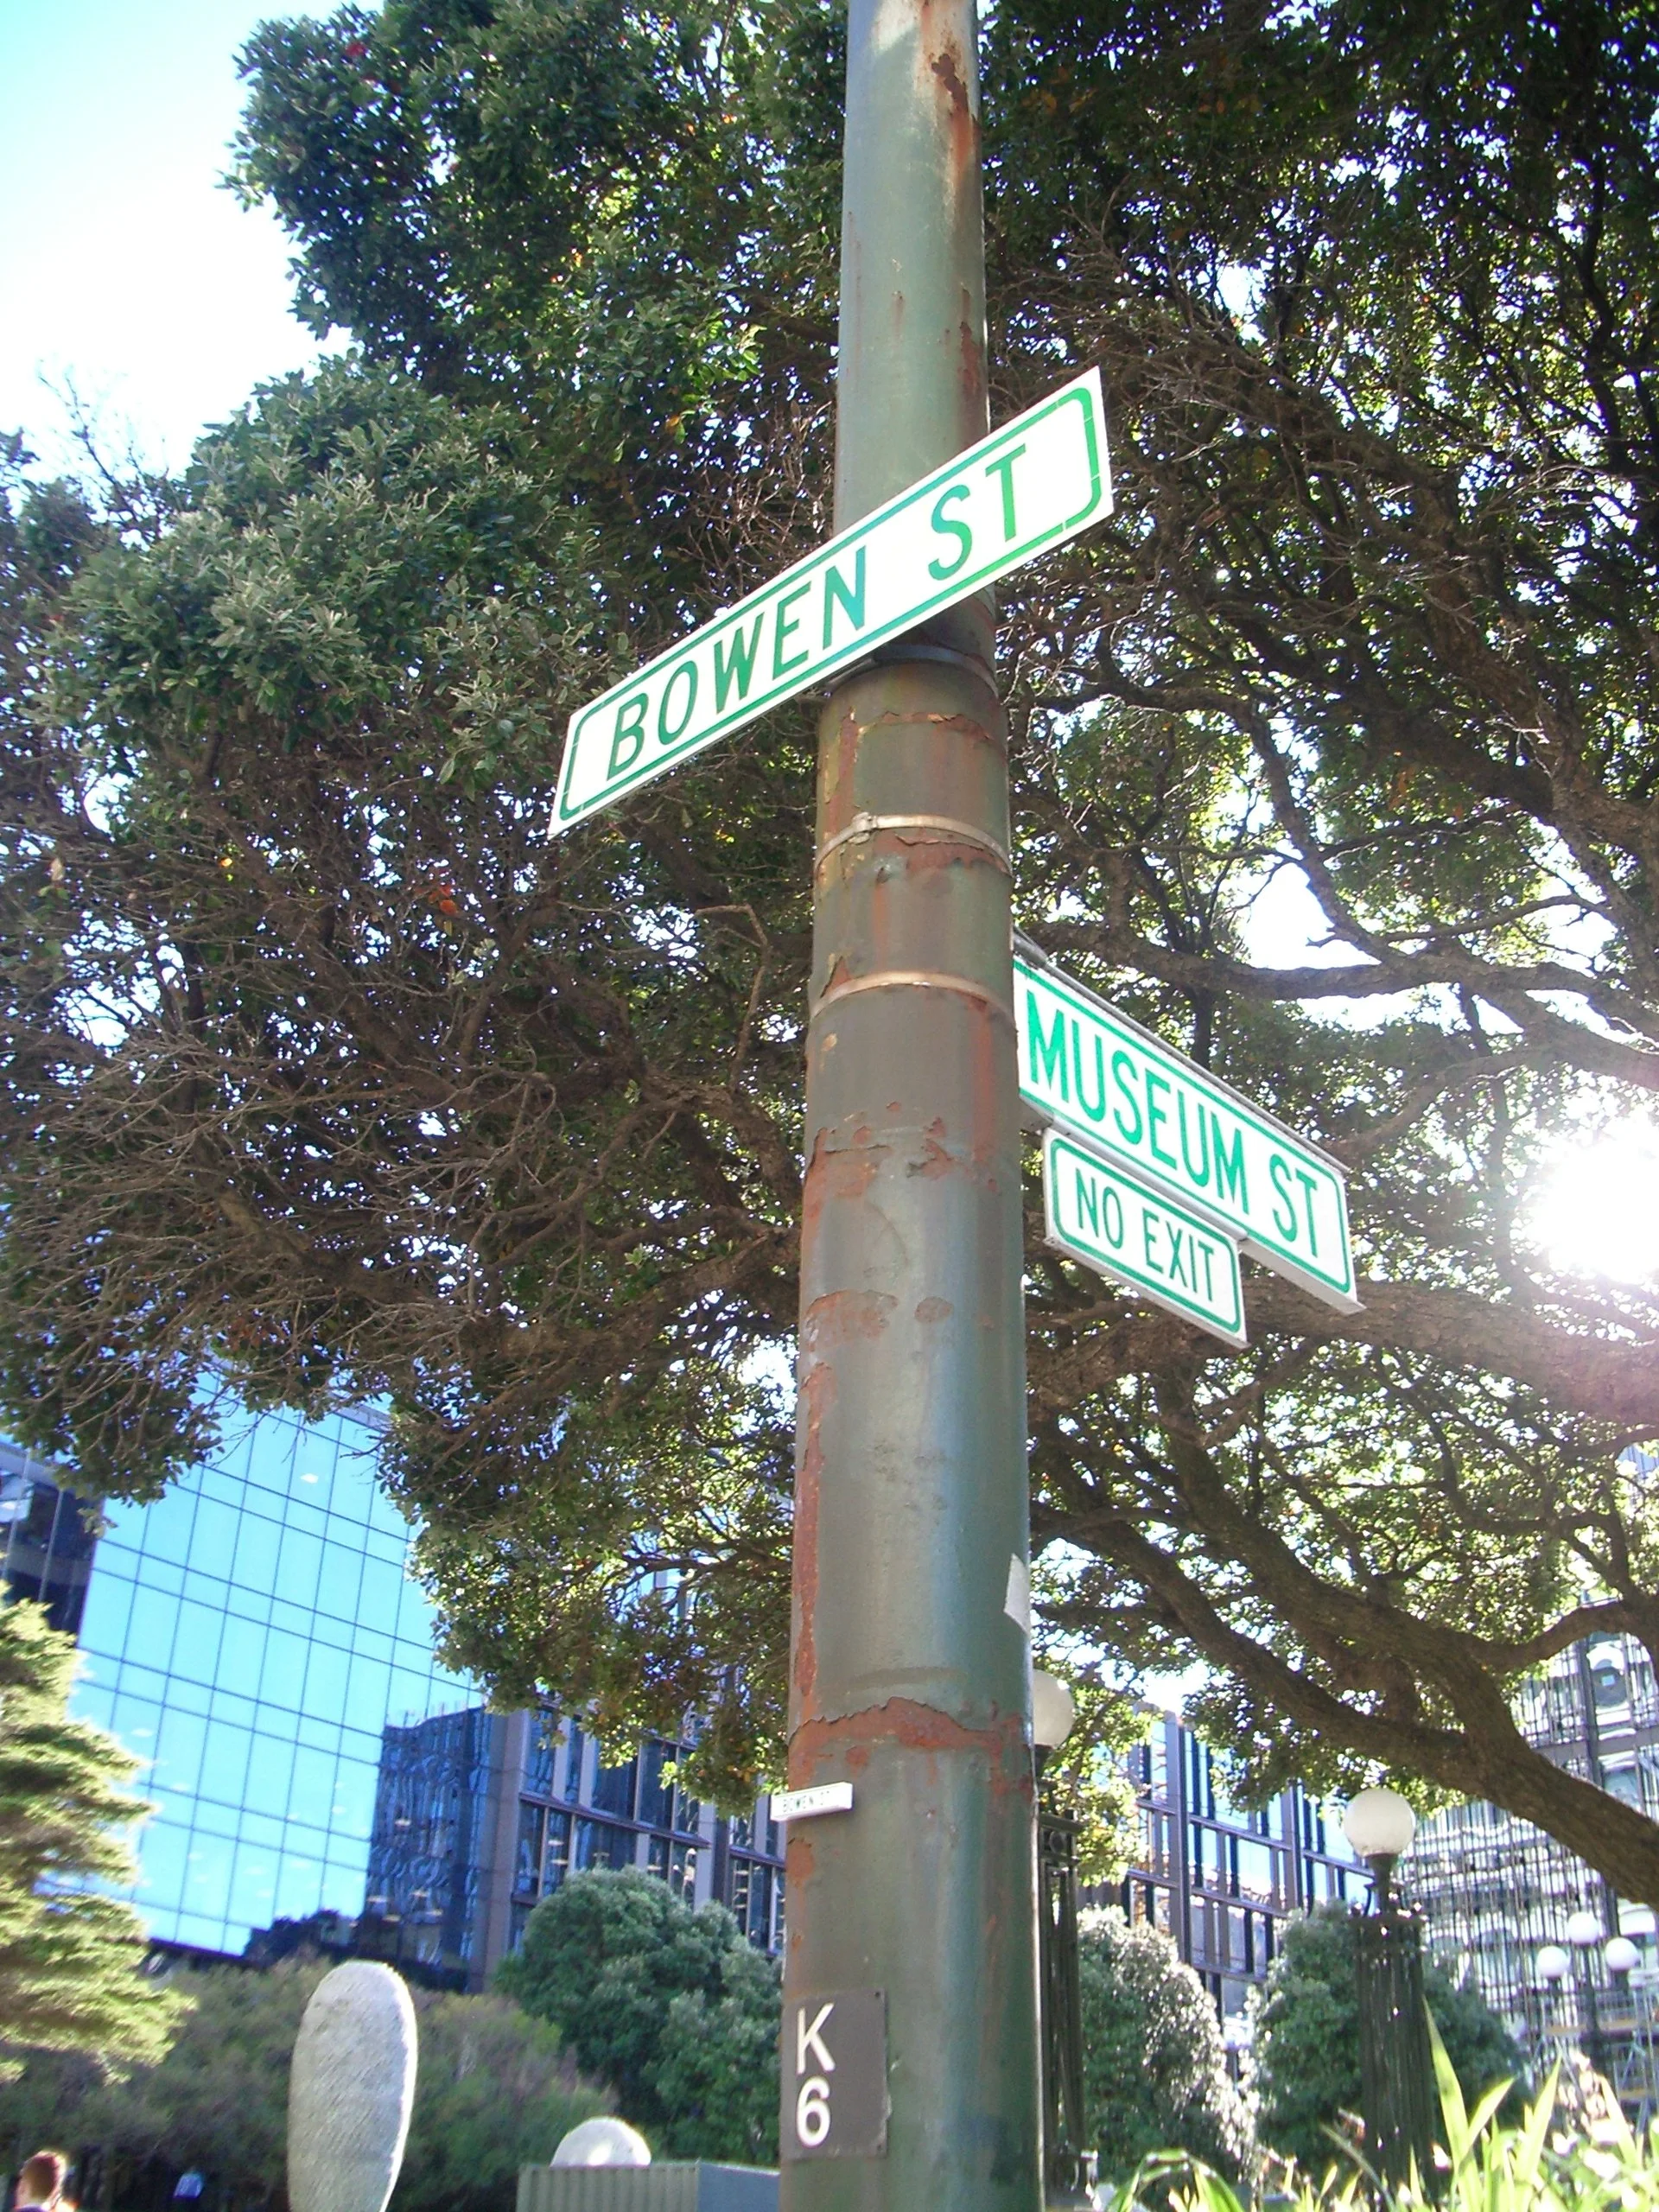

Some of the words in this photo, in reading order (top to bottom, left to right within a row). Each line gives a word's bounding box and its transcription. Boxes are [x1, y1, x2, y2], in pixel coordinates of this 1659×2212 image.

[607, 545, 866, 780] BOWEN
[928, 445, 1026, 580] ST
[1027, 990, 1249, 1215] MUSEUM
[1269, 1154, 1318, 1258] ST
[1076, 1168, 1123, 1249] NO
[1142, 1207, 1215, 1300] EXIT
[797, 2002, 836, 2074] K
[797, 2075, 831, 2147] 6
